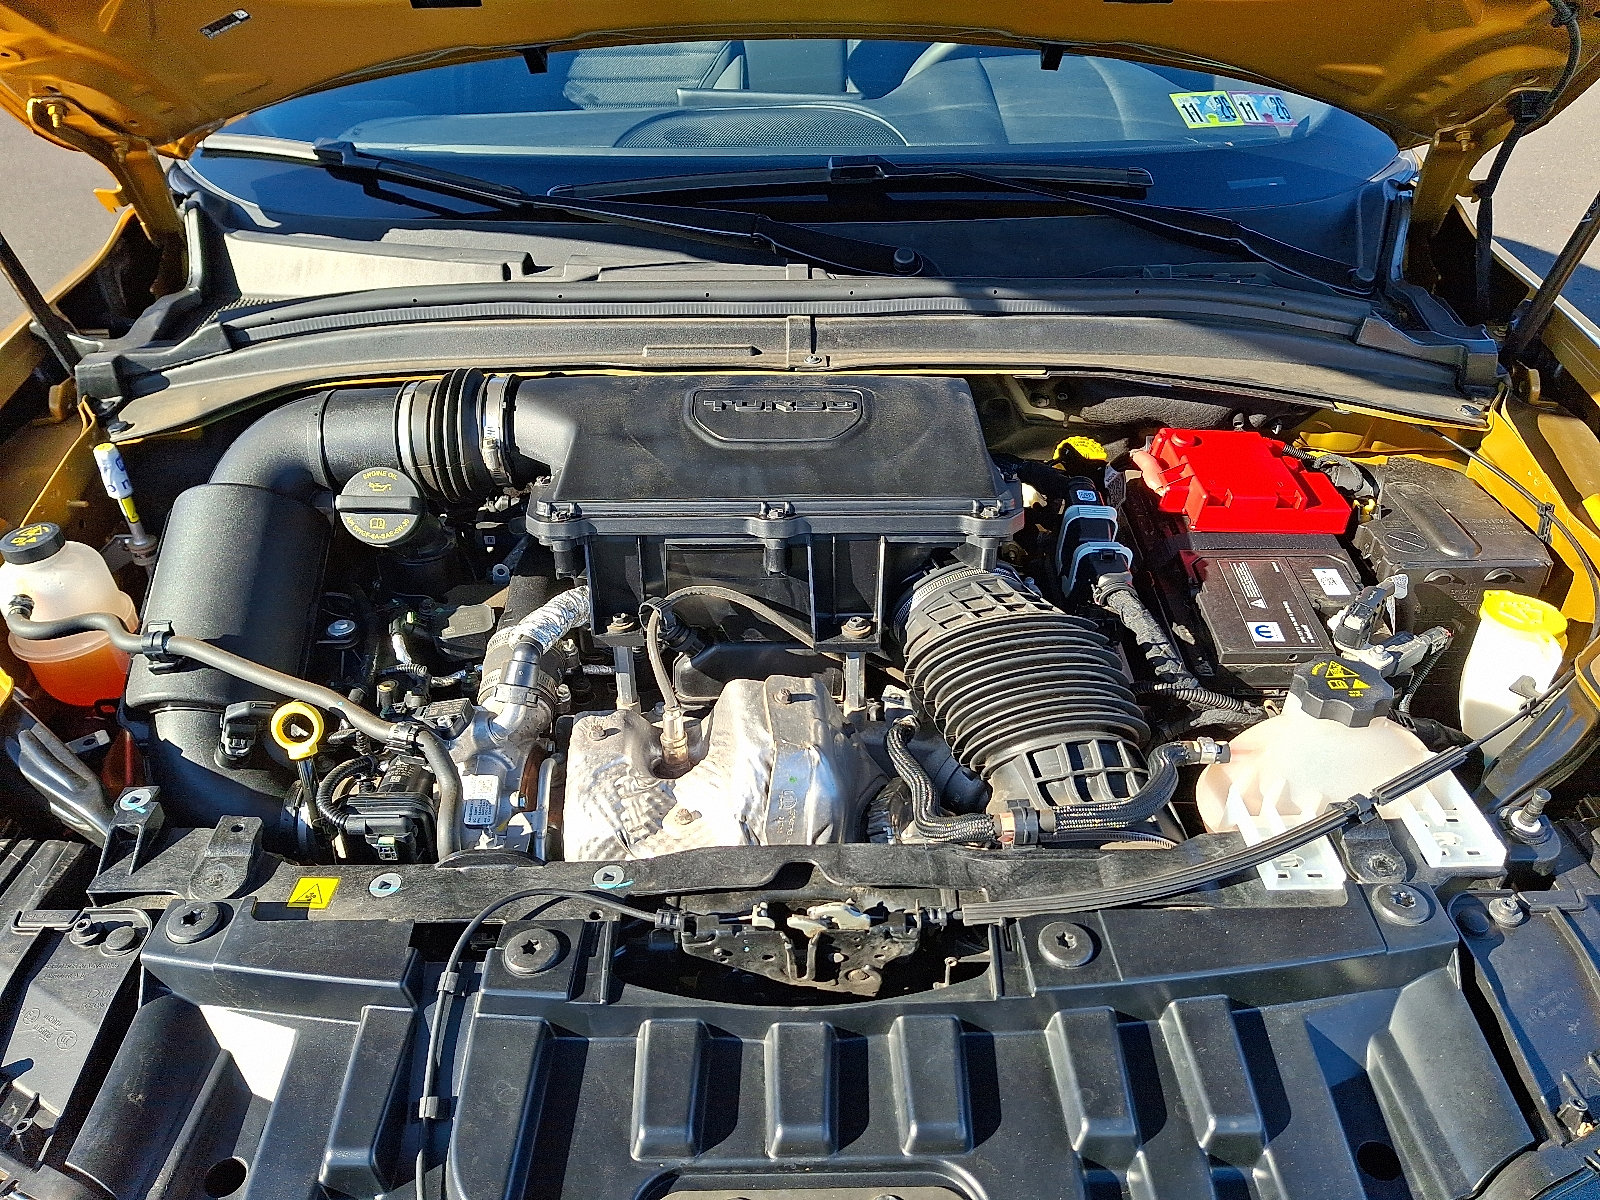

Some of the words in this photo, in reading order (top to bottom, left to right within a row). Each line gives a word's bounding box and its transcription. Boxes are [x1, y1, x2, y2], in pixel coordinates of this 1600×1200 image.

[1181, 102, 1204, 123] 11
[1213, 95, 1237, 119] 26
[1239, 101, 1260, 121] 11
[1268, 96, 1293, 120] 26
[362, 470, 387, 480] ENGINE
[387, 472, 398, 480] OIL
